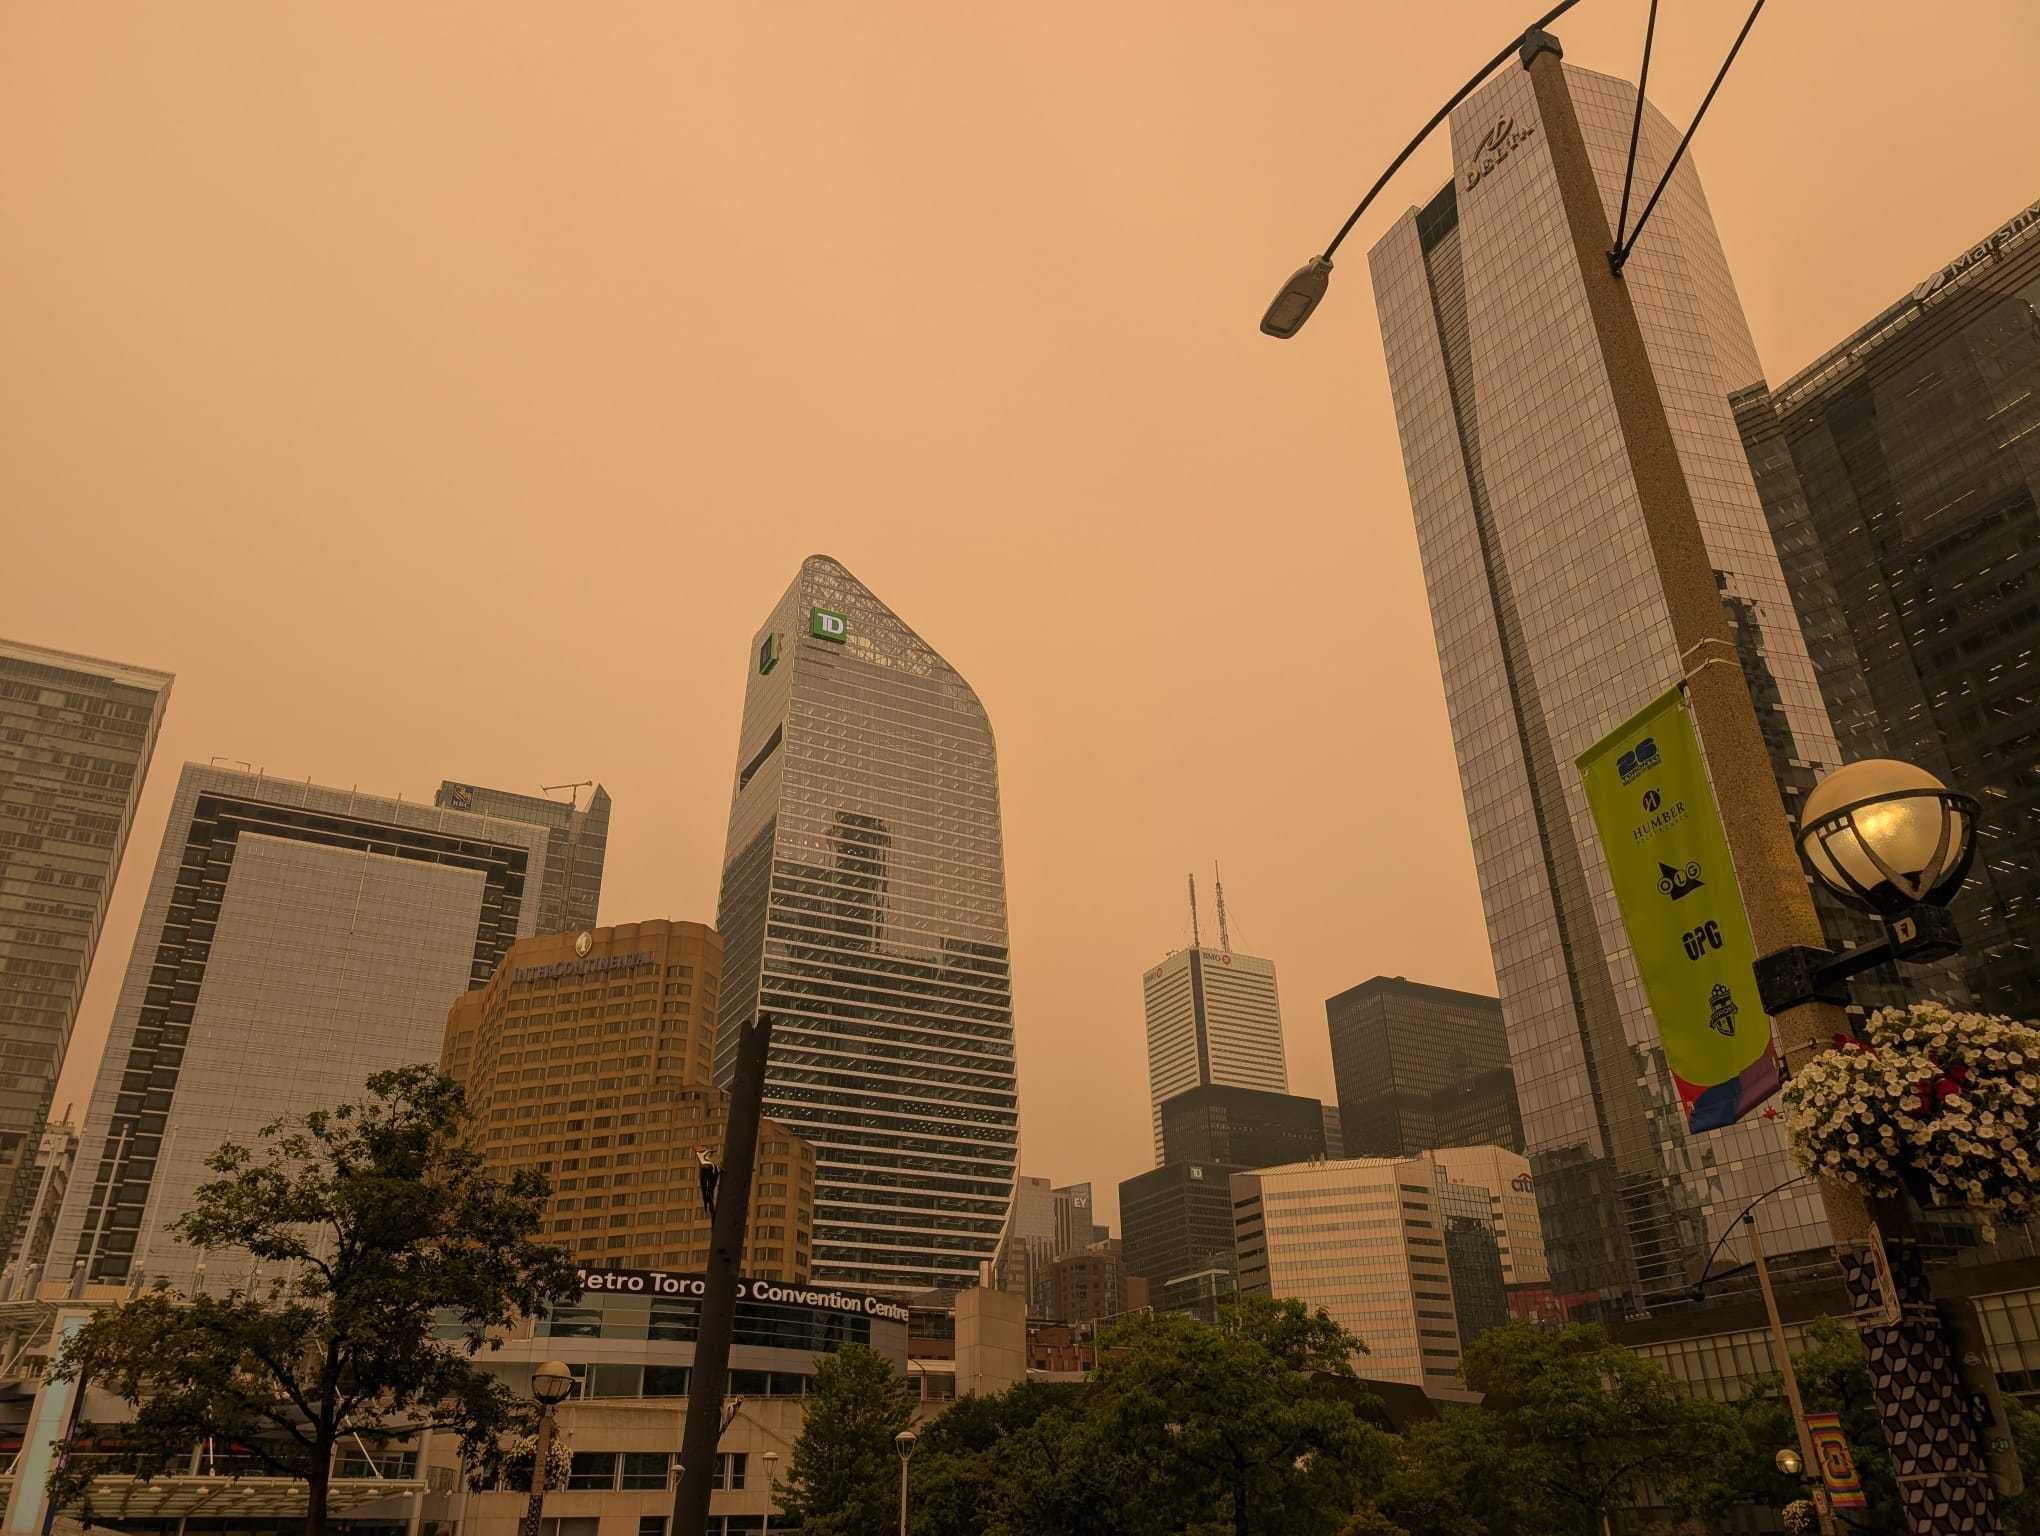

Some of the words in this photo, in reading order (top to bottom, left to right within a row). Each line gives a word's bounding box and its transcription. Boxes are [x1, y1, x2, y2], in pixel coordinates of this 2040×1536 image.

[817, 613, 844, 635] TD
[1633, 802, 1685, 840] HUMBER
[1658, 862, 1700, 894] OLG
[1073, 1197, 1087, 1208] EY
[649, 1272, 746, 1298] Toroo
[752, 1280, 861, 1313] Convention
[865, 1297, 909, 1323] Centre
